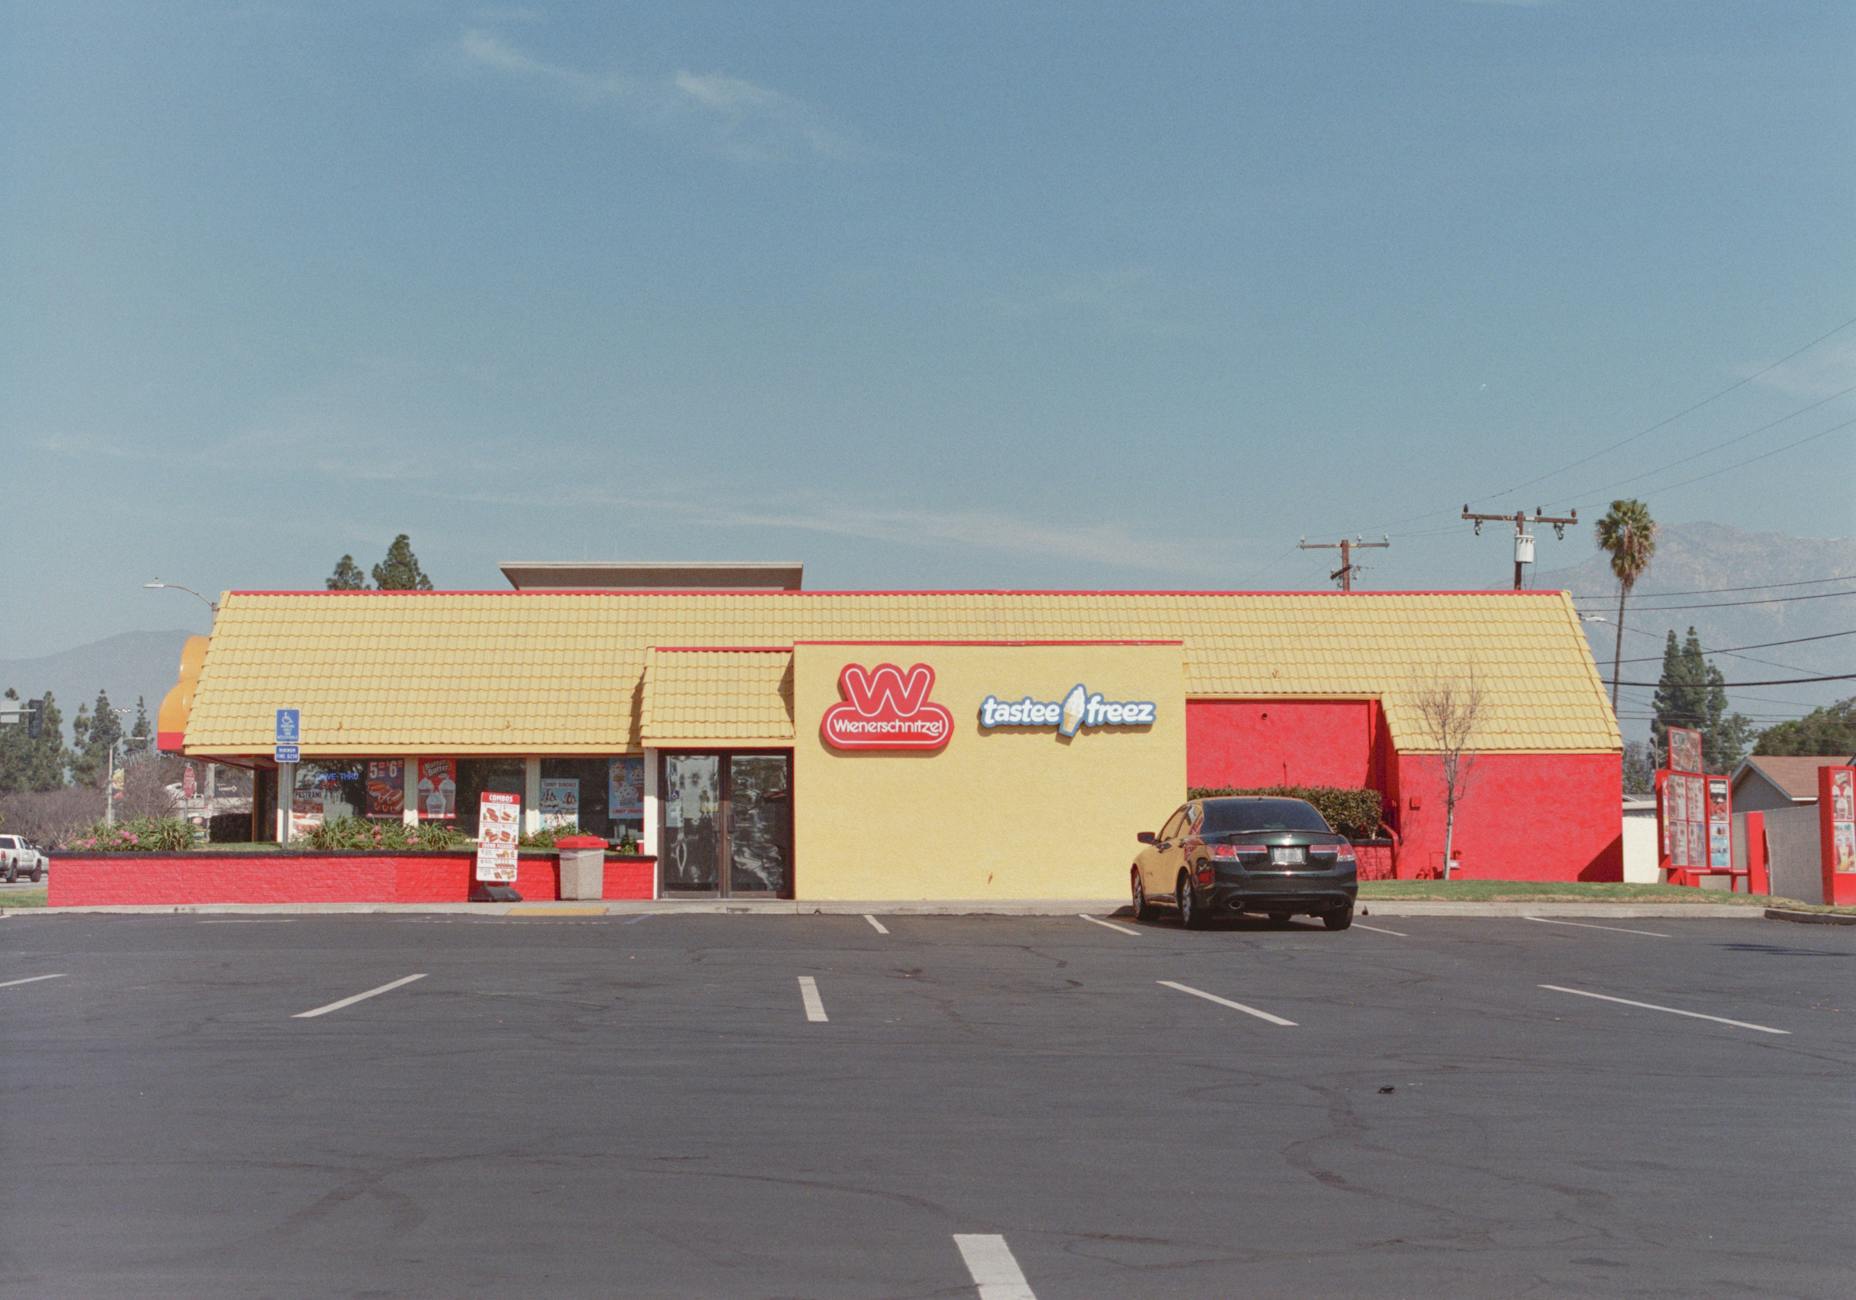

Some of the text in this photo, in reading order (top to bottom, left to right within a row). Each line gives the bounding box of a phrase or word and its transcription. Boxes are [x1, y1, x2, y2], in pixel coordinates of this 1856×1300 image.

[845, 668, 930, 717] W
[983, 695, 1154, 725] tastee freez
[833, 719, 943, 736] Wienerschnitzel
[489, 793, 513, 803] COMBOS
